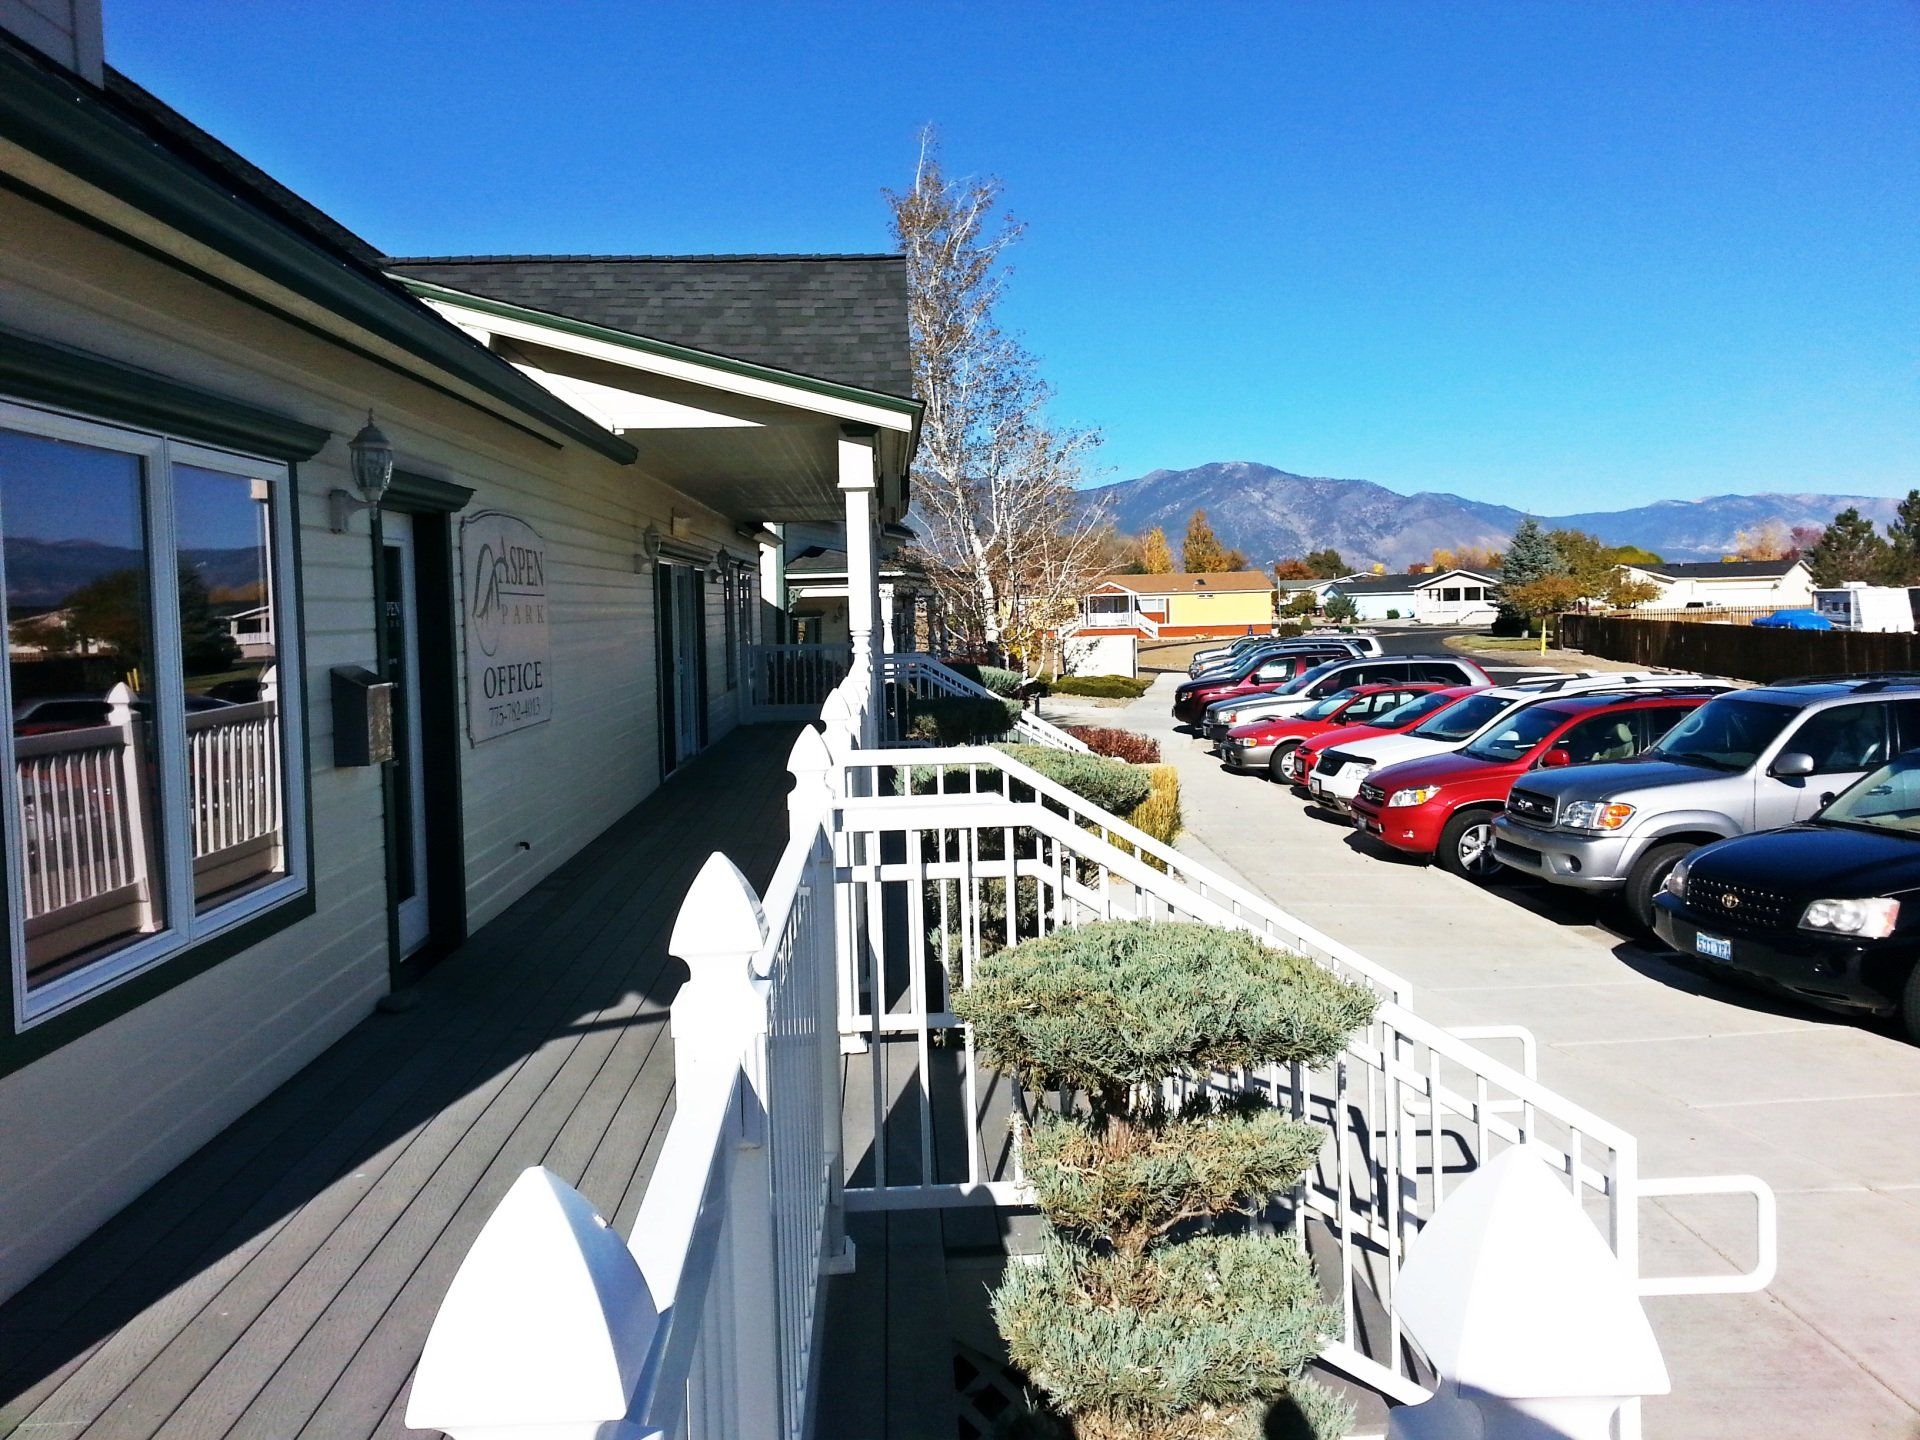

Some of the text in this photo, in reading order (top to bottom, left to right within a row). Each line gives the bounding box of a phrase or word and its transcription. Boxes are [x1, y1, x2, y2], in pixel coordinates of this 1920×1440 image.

[498, 537, 544, 587] ASPEN
[501, 604, 544, 624] PARK
[484, 661, 543, 699] OFFICE
